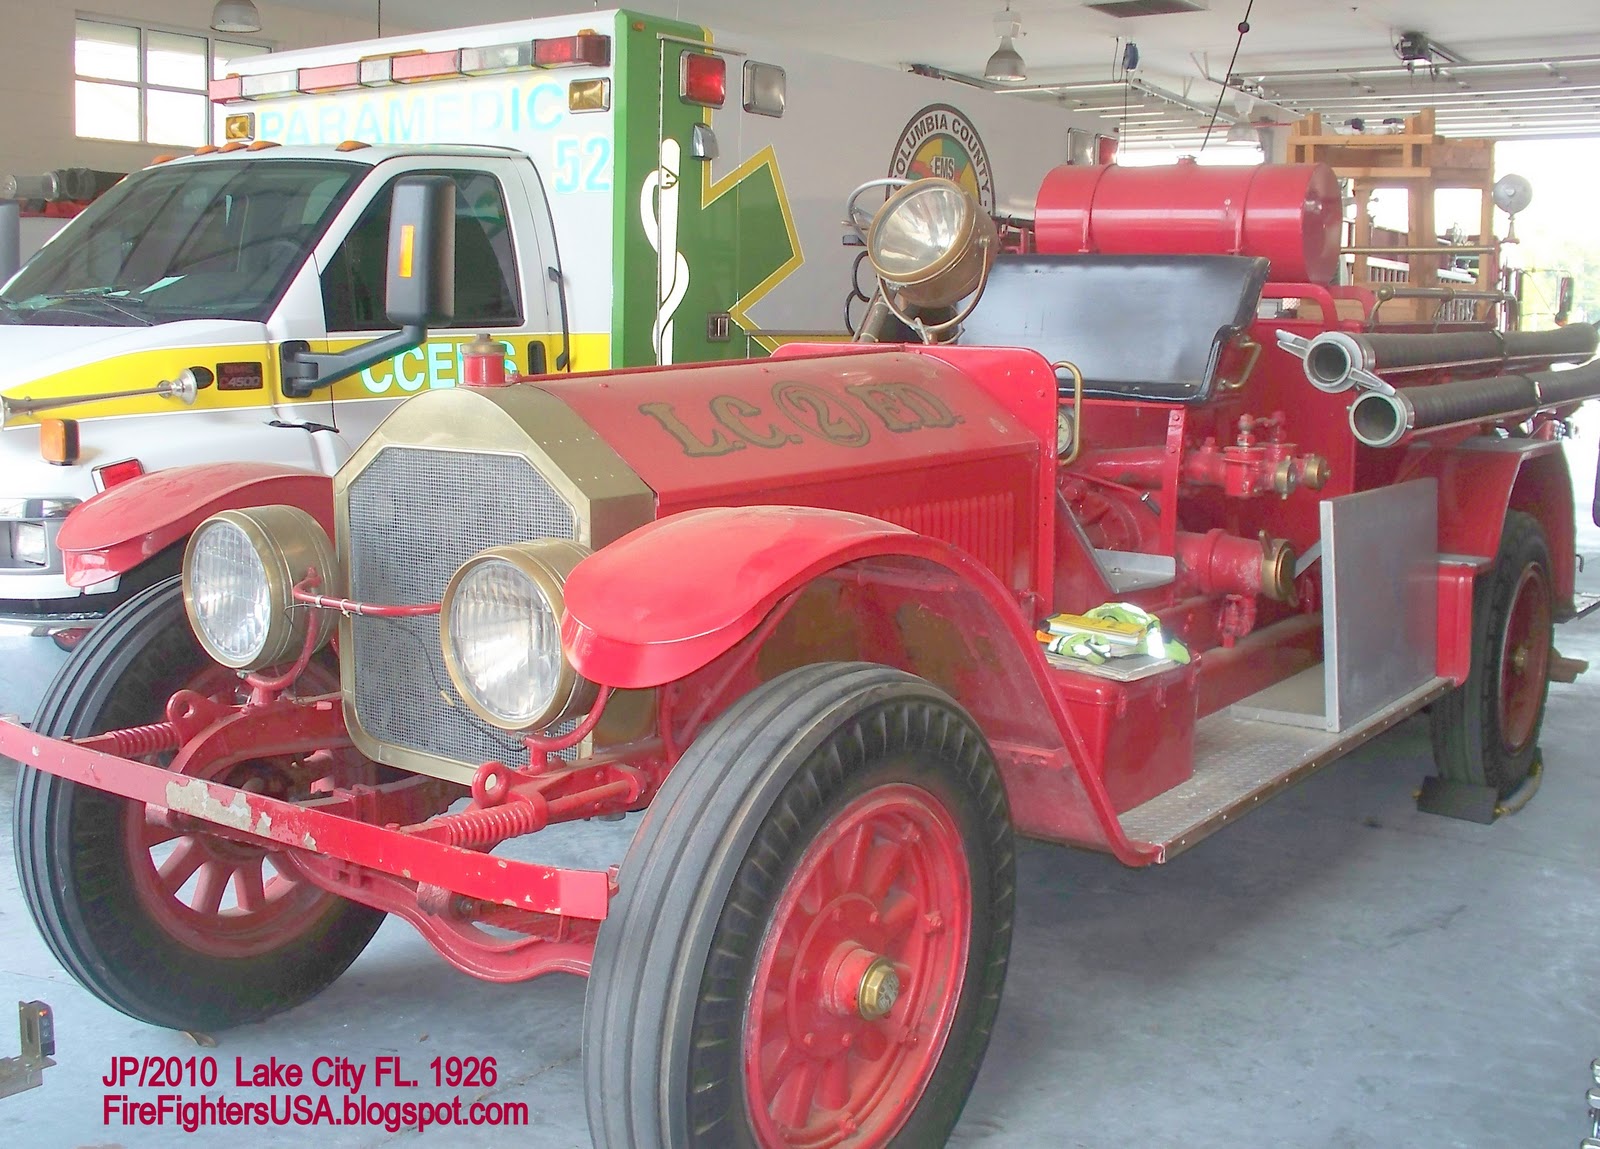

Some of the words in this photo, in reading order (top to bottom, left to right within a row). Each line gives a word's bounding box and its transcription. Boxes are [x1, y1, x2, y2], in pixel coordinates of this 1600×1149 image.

[258, 79, 564, 145] PARAMEDIC
[553, 137, 611, 193] 52
[934, 157, 954, 180] EMS
[952, 118, 990, 193] COUNTY
